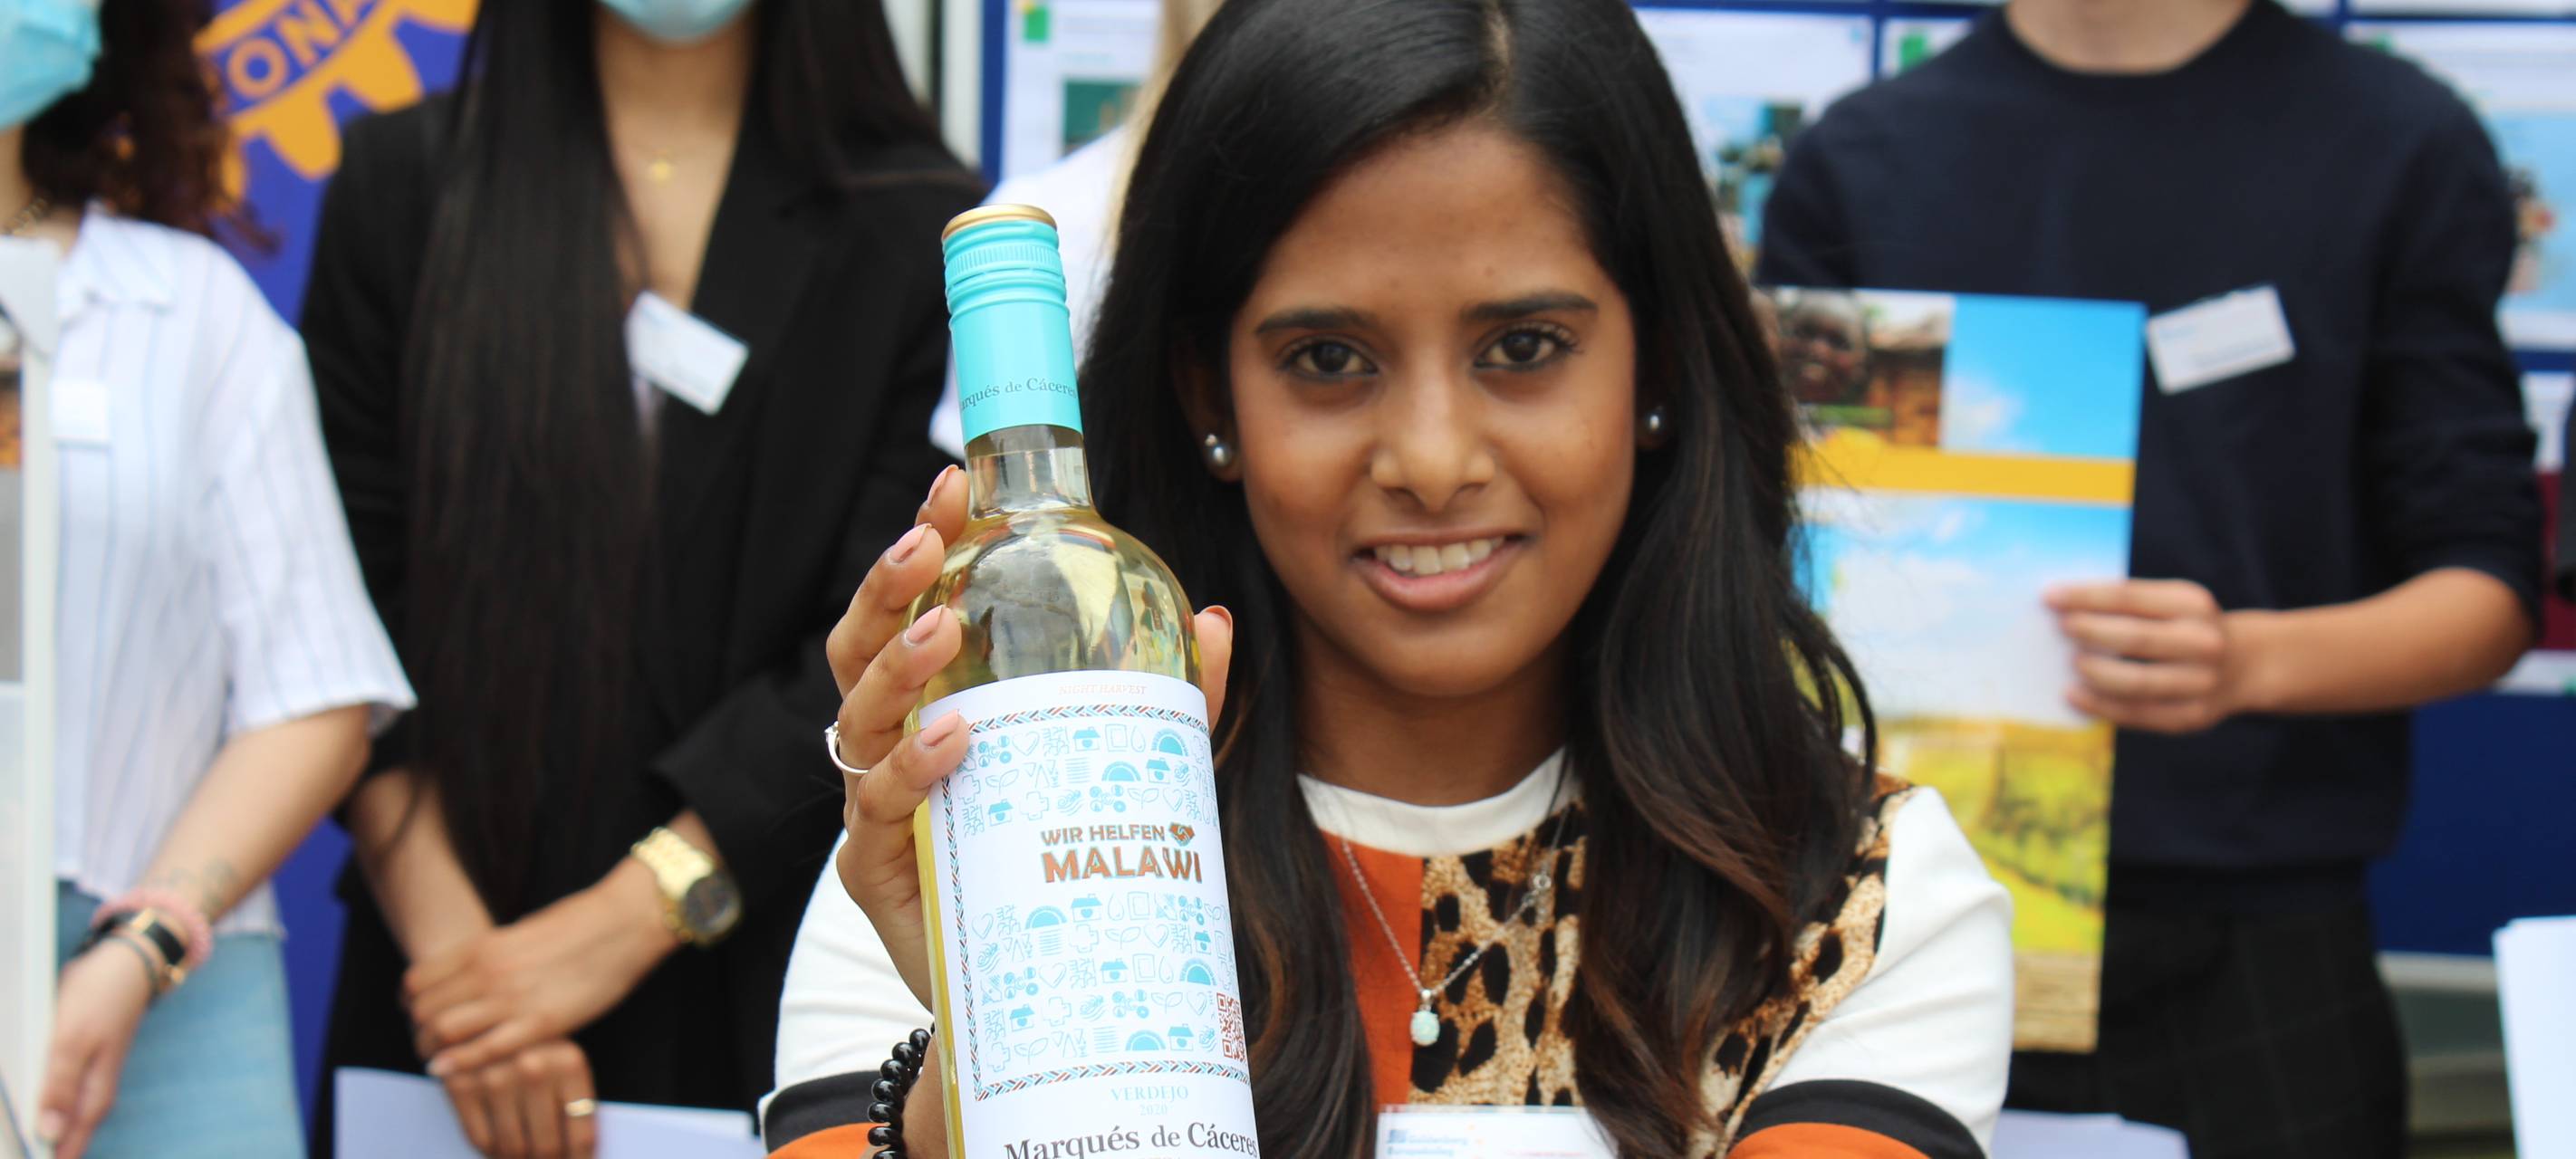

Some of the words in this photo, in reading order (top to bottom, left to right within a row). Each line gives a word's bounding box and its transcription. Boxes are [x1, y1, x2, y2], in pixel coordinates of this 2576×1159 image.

[1005, 380, 1022, 393] de
[1041, 827, 1083, 846] WIR
[1089, 824, 1166, 842] HELFEN
[1042, 845, 1202, 884] MALAWI
[1110, 1086, 1188, 1102] VERDEJO
[1139, 1104, 1168, 1116] 2020
[1004, 1125, 1139, 1159] Marqués
[1151, 1125, 1180, 1148] de
[1187, 1122, 1257, 1158] Cáceres
